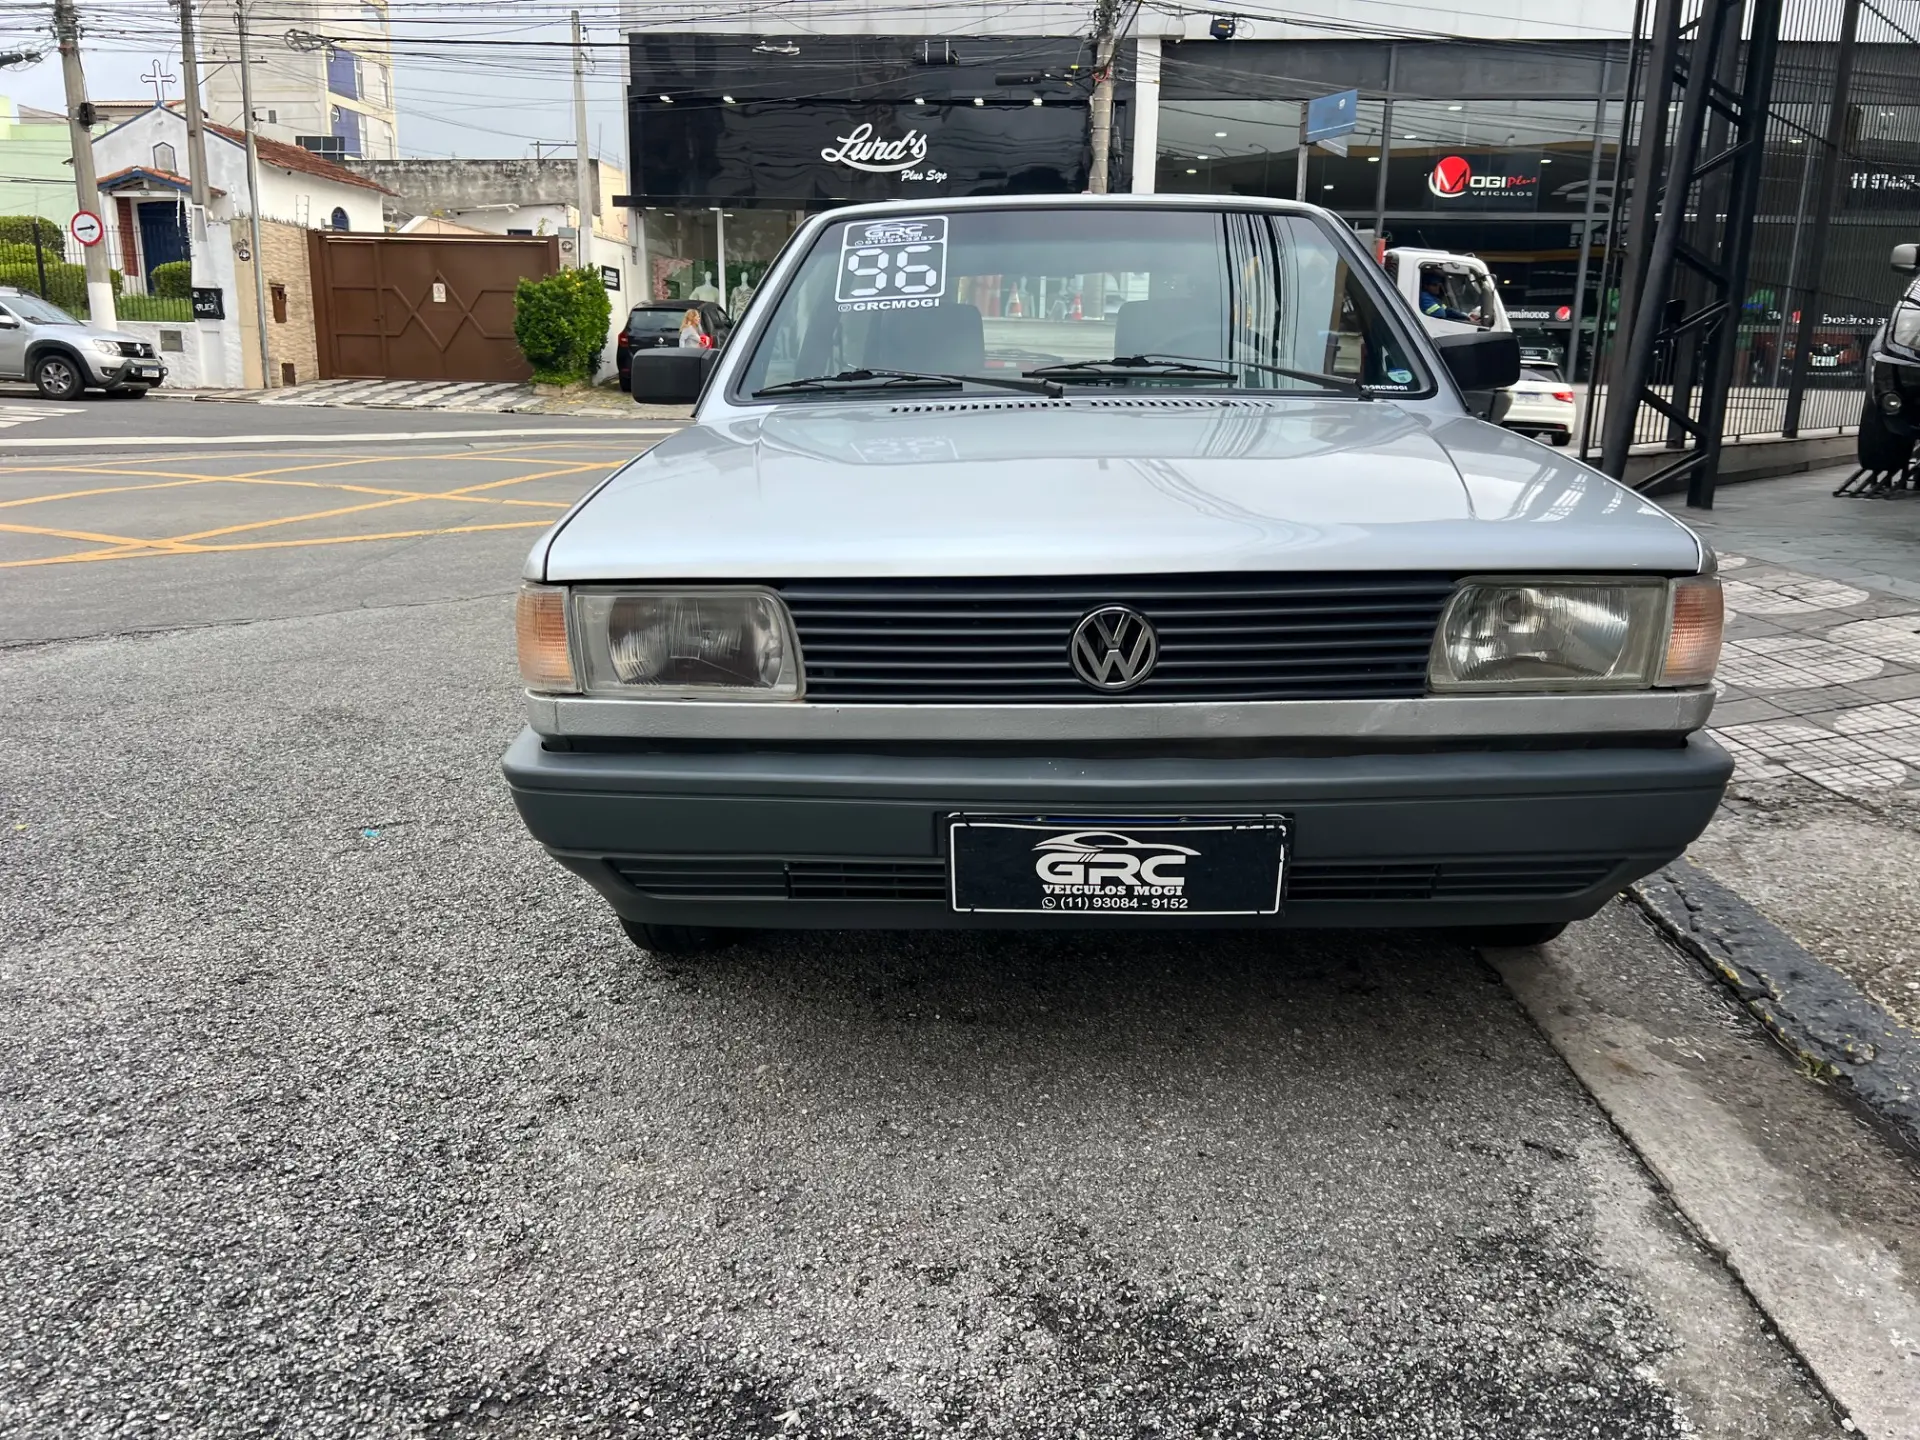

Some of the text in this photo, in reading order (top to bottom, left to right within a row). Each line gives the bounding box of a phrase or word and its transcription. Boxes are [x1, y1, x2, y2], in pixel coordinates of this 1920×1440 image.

[901, 169, 948, 183] Plus Size
[864, 226, 923, 238] GRC
[847, 245, 937, 296] 96
[853, 299, 939, 311] GRCMOGI
[1036, 852, 1187, 886] GRC
[1042, 884, 1183, 896] VEICULOS MOGI
[1060, 897, 1089, 909] (11)
[1093, 897, 1138, 908] 93084
[1151, 898, 1188, 908] 9152
